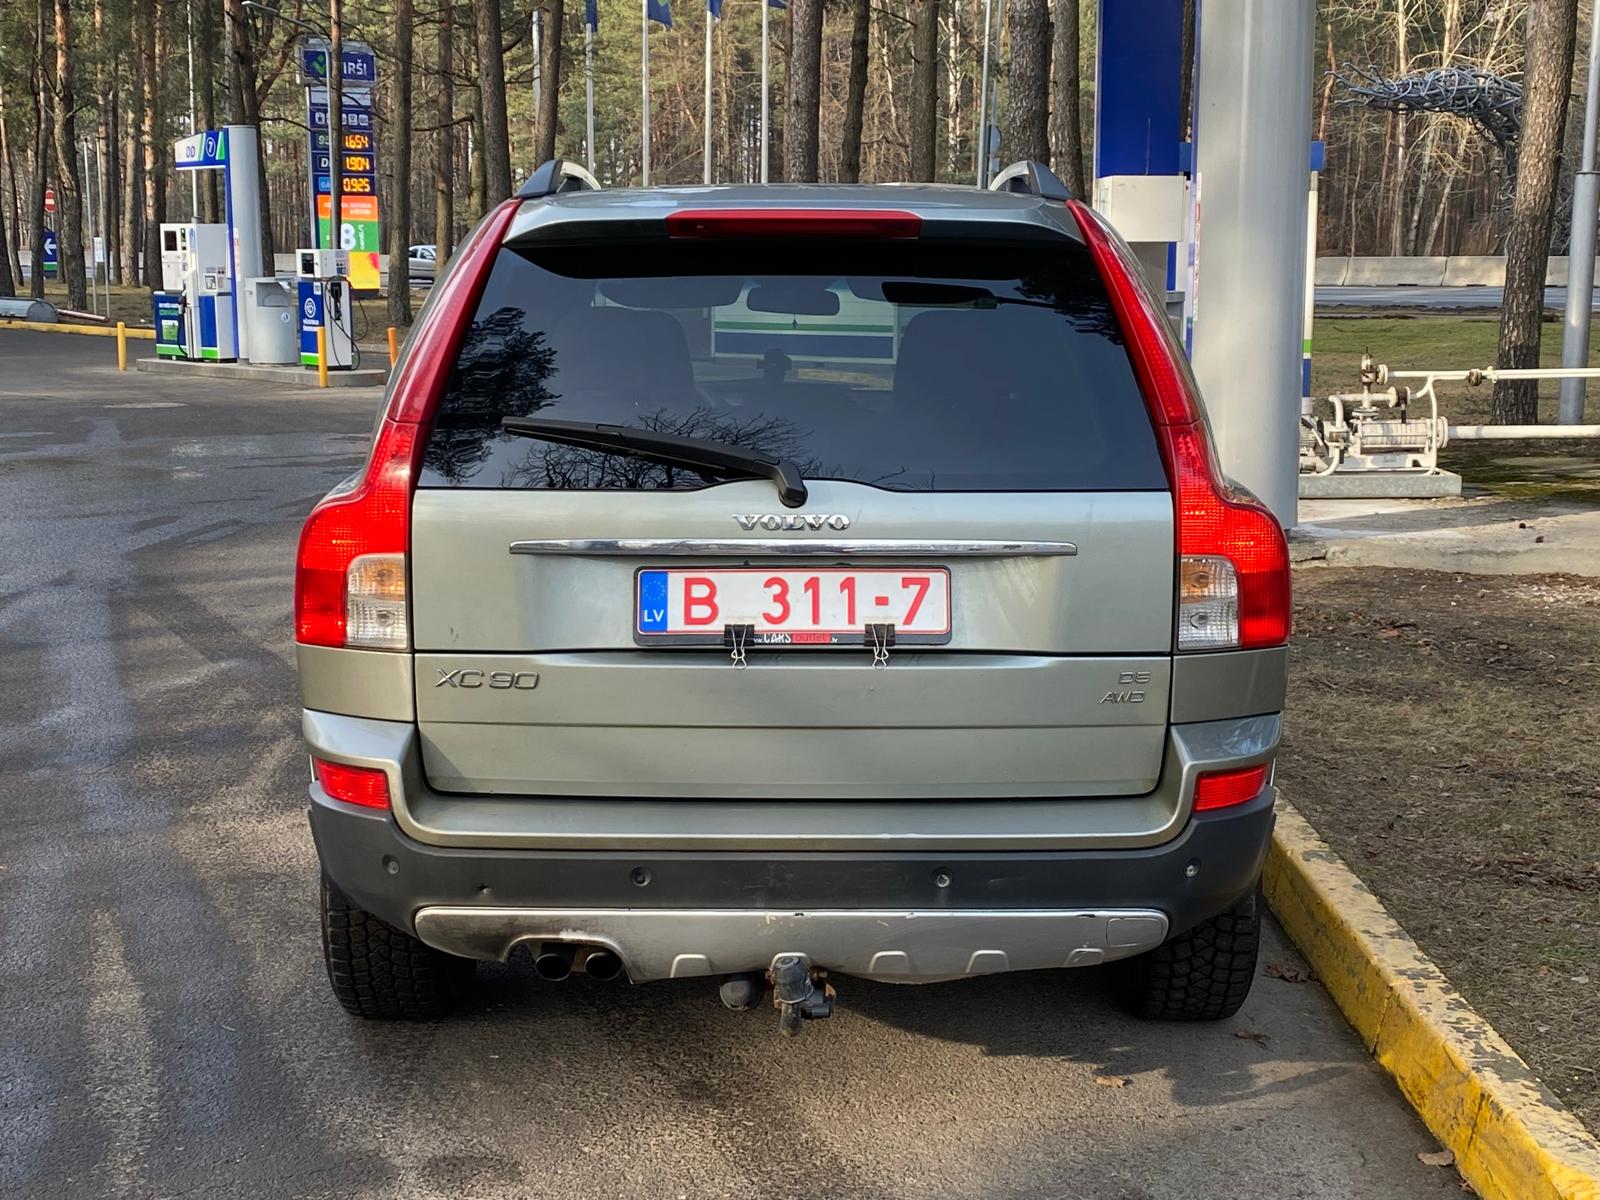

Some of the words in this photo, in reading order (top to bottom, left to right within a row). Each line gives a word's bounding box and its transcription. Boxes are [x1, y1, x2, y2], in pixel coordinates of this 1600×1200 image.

[343, 58, 367, 76] IRŠI
[733, 514, 850, 531] VOLVO
[684, 577, 719, 625] B
[762, 576, 930, 626] 311-7
[644, 609, 664, 623] LV
[1099, 691, 1145, 704] AWD
